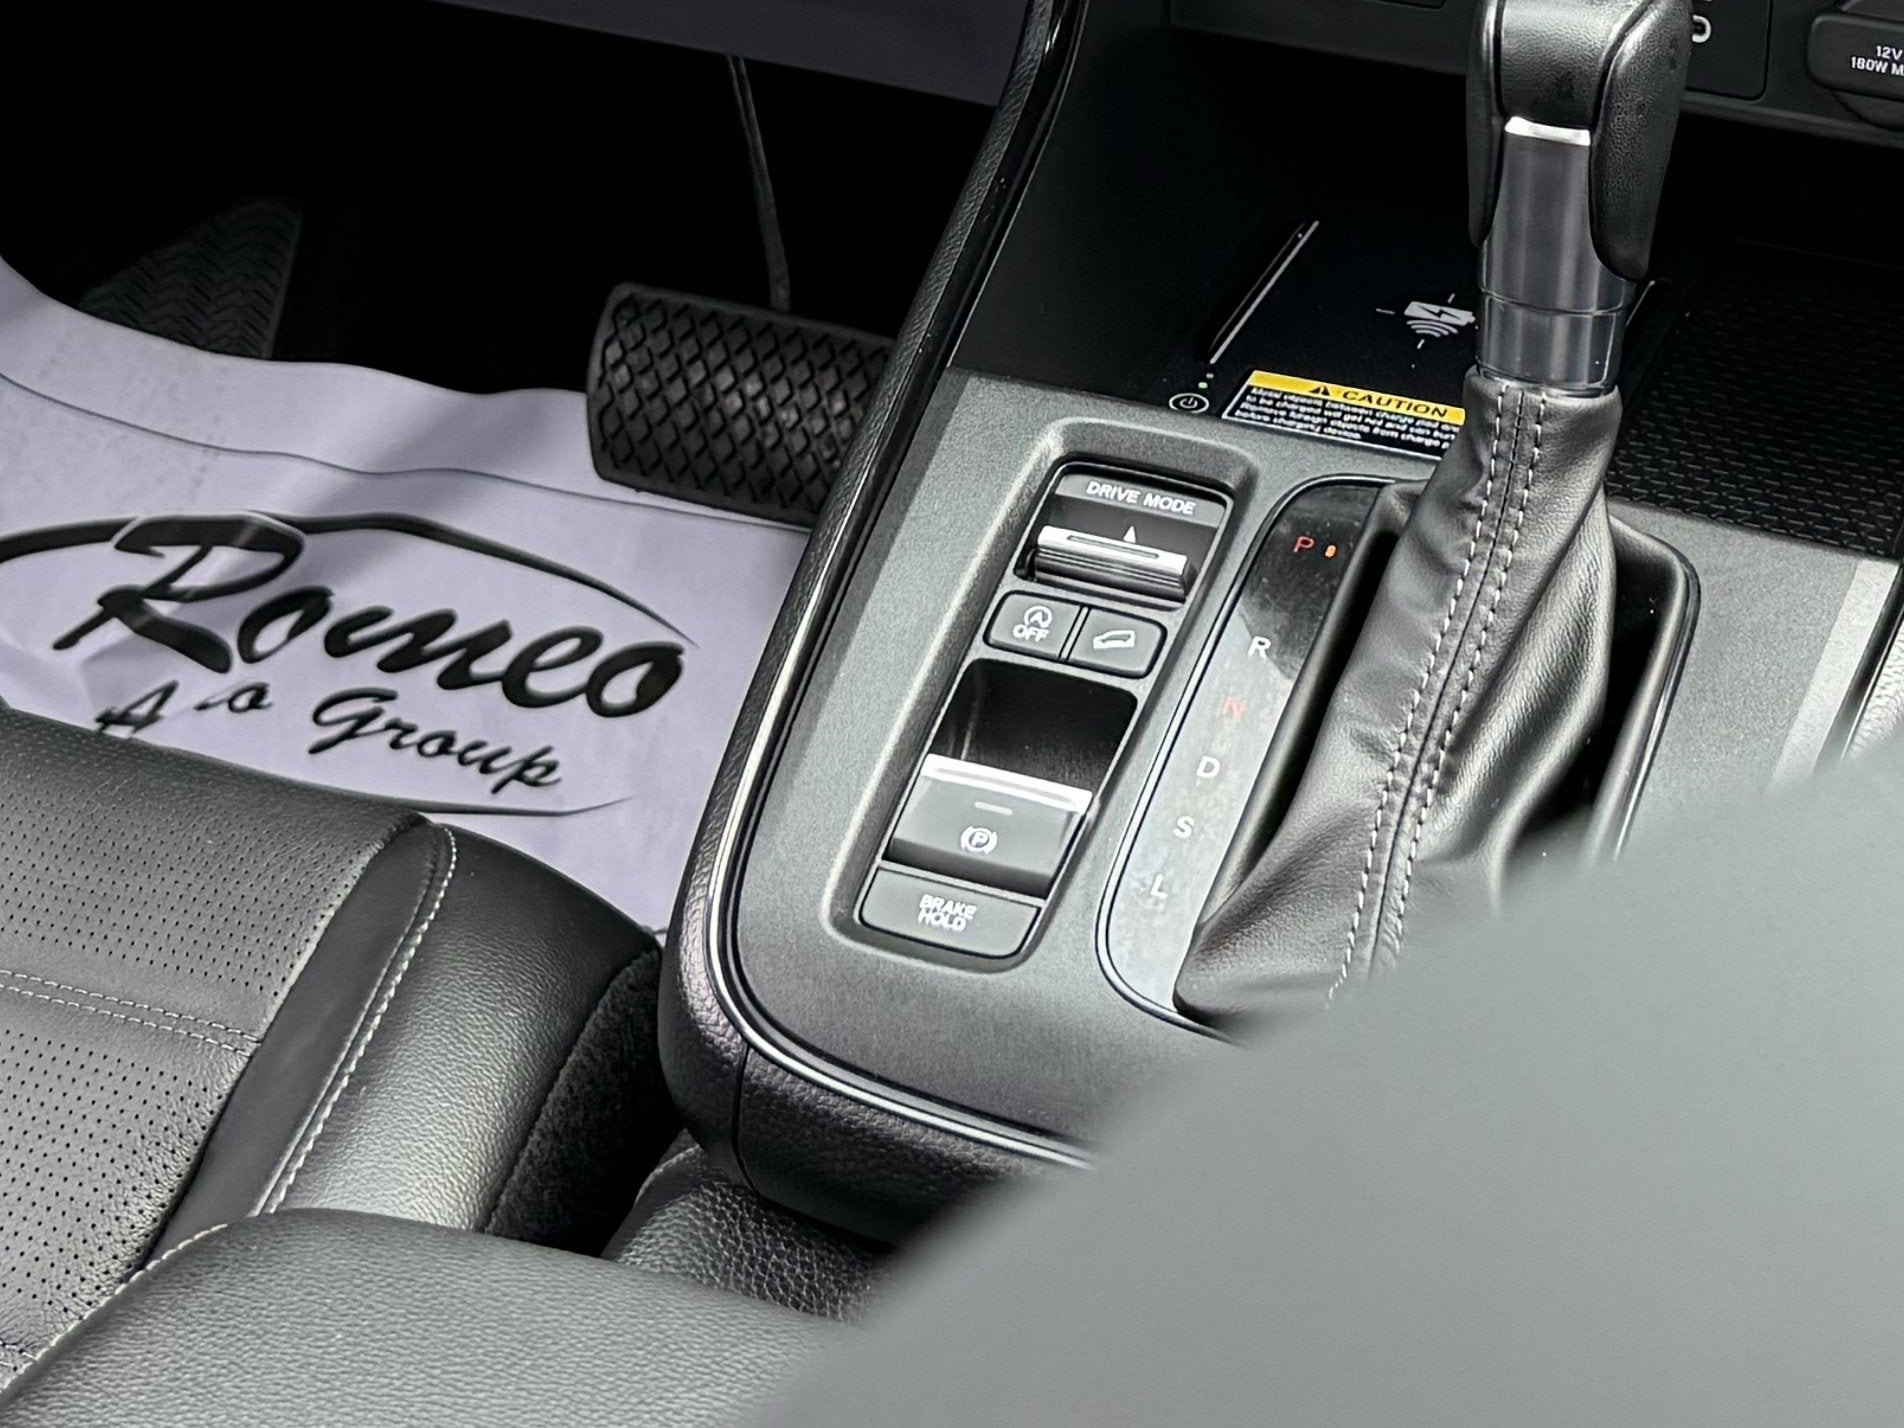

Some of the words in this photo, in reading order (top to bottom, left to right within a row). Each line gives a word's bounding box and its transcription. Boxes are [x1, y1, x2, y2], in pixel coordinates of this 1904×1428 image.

[1850, 56, 1889, 74] 180W
[1876, 45, 1903, 61] 12V
[1342, 390, 1448, 418] CAUTION
[1086, 481, 1139, 505] DRIVE
[1143, 492, 1196, 516] MODE
[1294, 535, 1314, 554] P
[52, 512, 684, 718] Romeo
[1013, 624, 1049, 643] OFF
[1248, 635, 1272, 659] R
[1223, 695, 1246, 720] N
[307, 687, 561, 796] Group
[1197, 755, 1221, 779] D
[1172, 815, 1194, 838] S
[1150, 873, 1168, 899] L
[918, 893, 977, 920] BRAKE
[917, 908, 968, 933] HOLD
